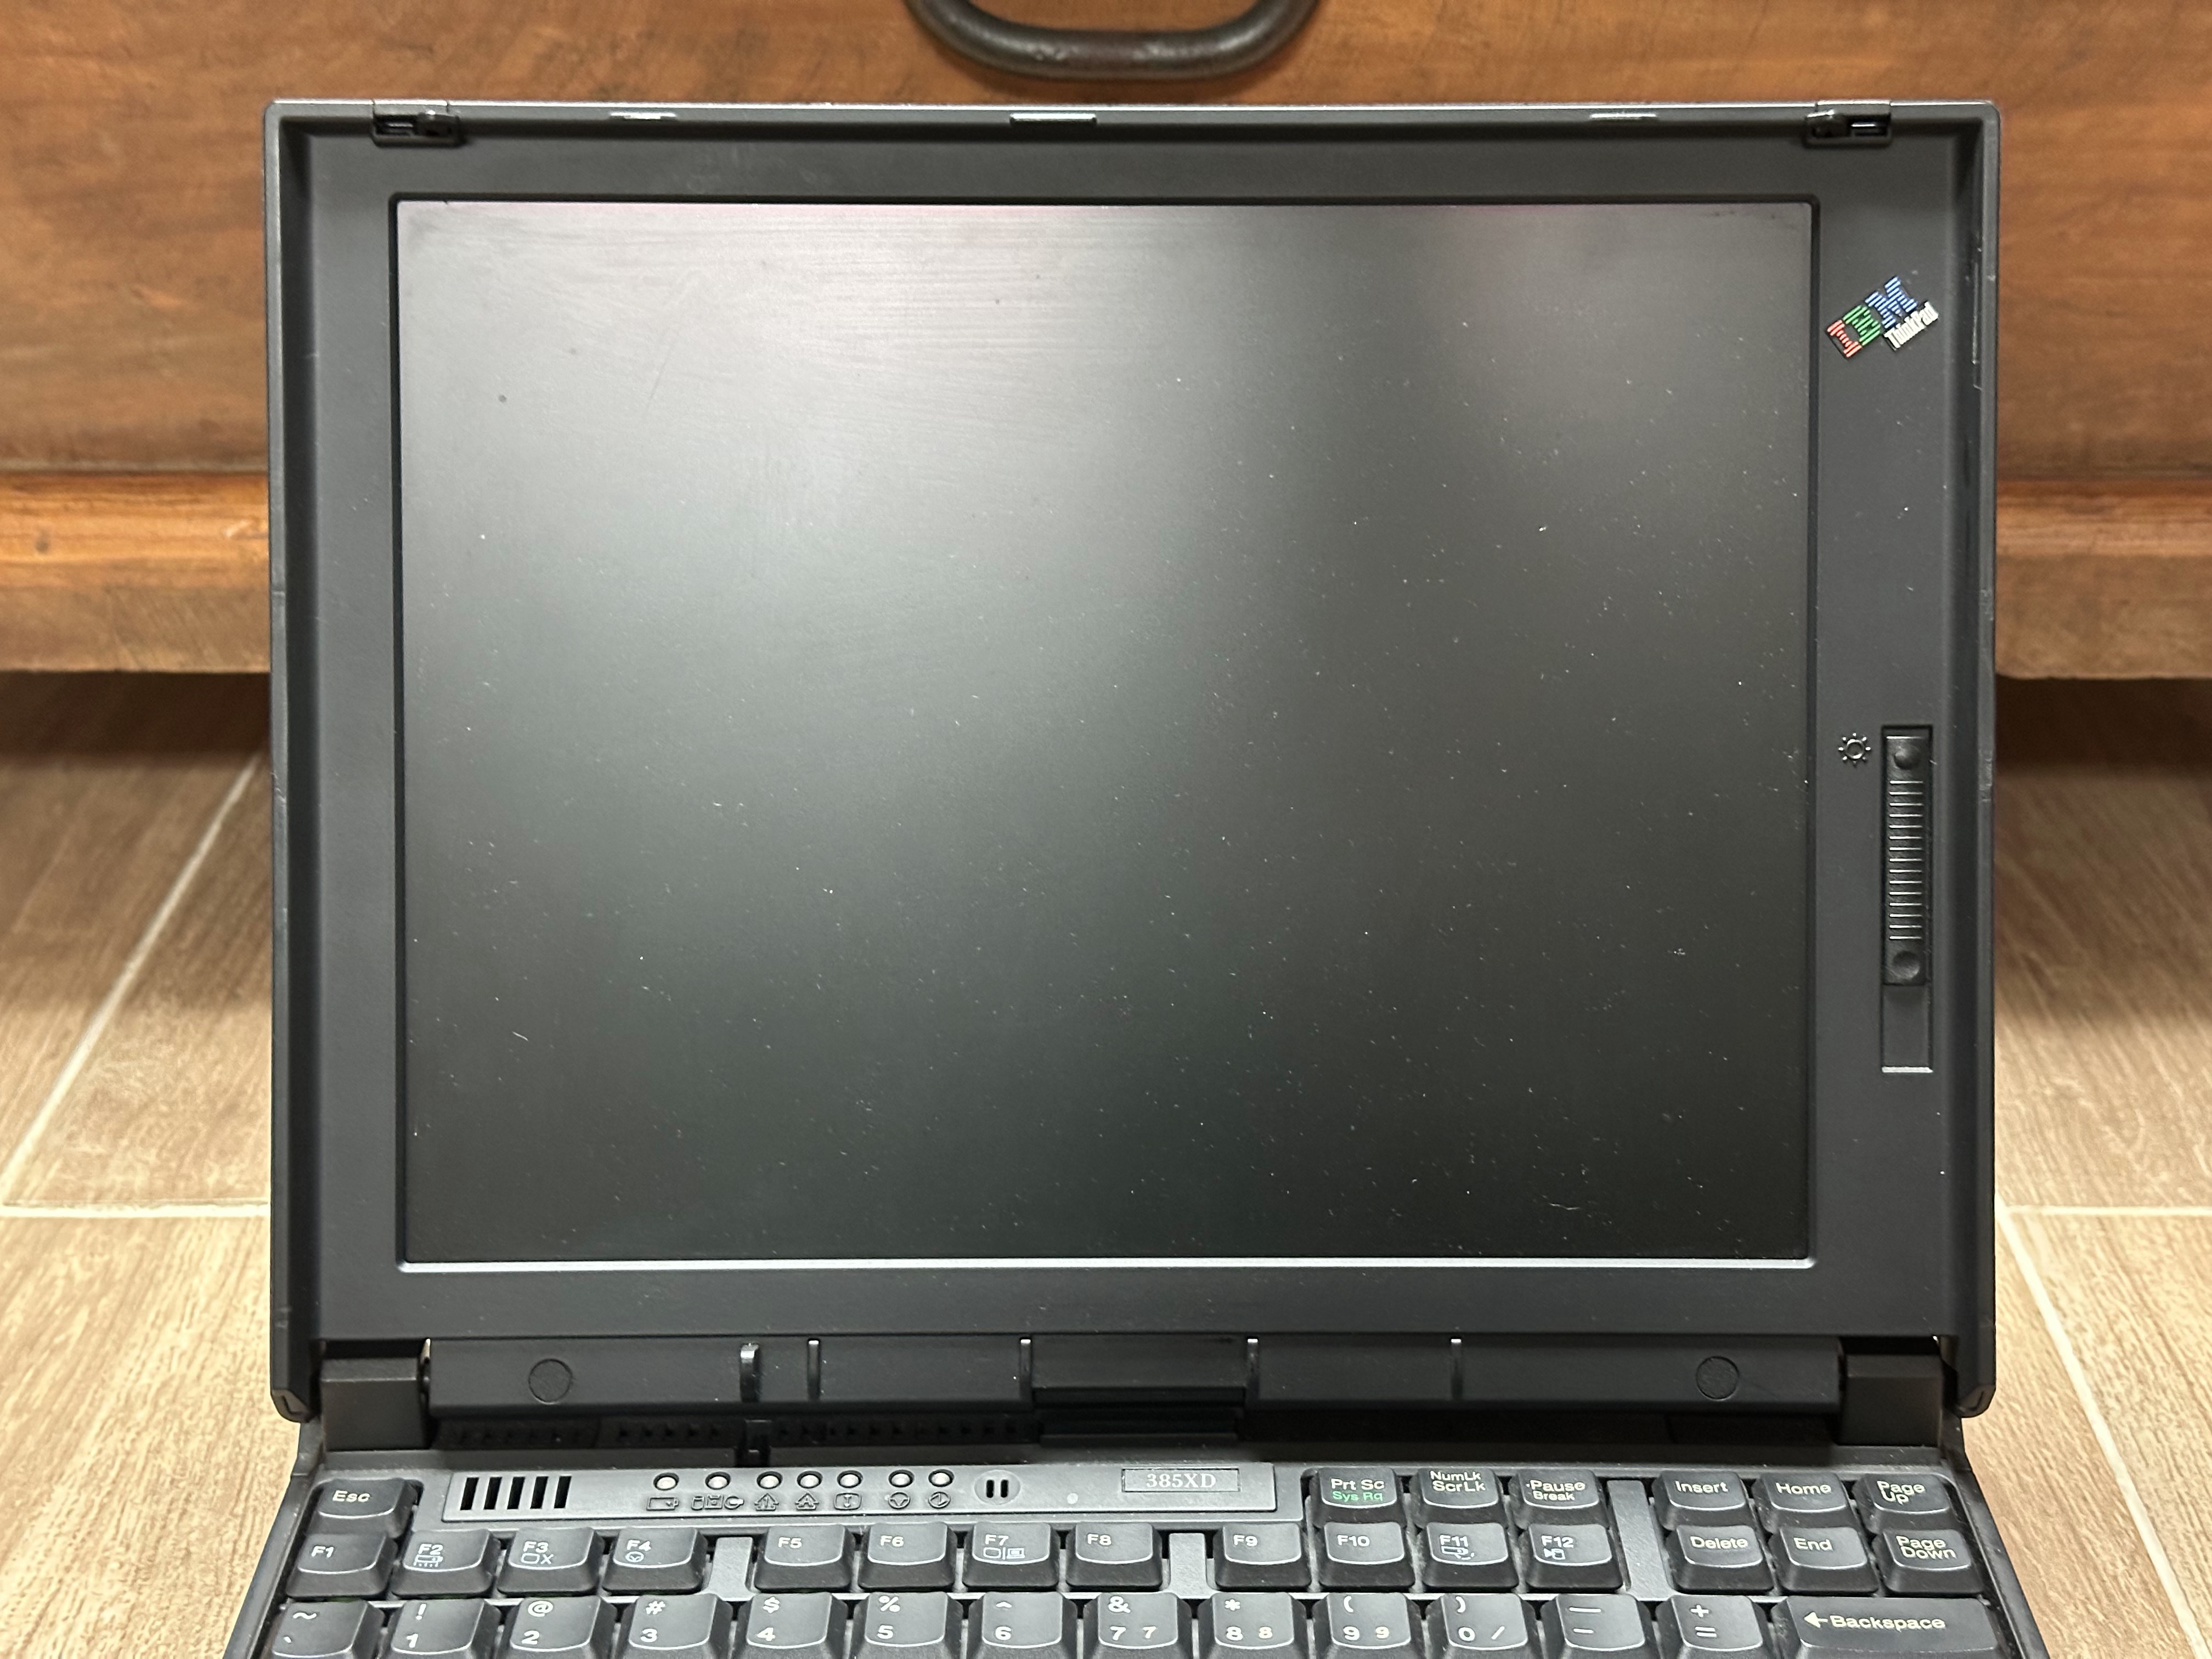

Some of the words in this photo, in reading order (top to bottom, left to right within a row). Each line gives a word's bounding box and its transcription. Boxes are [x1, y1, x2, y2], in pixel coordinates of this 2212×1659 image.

[1826, 276, 1918, 358] IBM
[1884, 301, 1939, 349] ThinkPad
[1144, 1472, 1218, 1491] 385XD
[1430, 1470, 1481, 1481] NumLk
[1331, 1478, 1357, 1491] Prt
[1361, 1479, 1385, 1491] Sc
[1432, 1479, 1486, 1492] ScrLk
[1530, 1480, 1585, 1493] Pause
[1675, 1481, 1729, 1493] Insert
[1775, 1482, 1832, 1495] Home
[1877, 1481, 1926, 1495] Page
[332, 1490, 370, 1503] Esc
[1332, 1491, 1358, 1502] Sys
[1362, 1491, 1384, 1502] Rq
[1533, 1489, 1576, 1501] Break
[1881, 1488, 1910, 1505] Up
[627, 1539, 651, 1553] F4
[778, 1537, 802, 1549] F5
[880, 1535, 904, 1547] F6
[985, 1534, 1009, 1546] F7
[1087, 1533, 1111, 1545] F8
[1233, 1534, 1258, 1547] F9
[1337, 1534, 1370, 1547] F10
[1440, 1534, 1469, 1547] F11
[1542, 1534, 1575, 1549] F12
[1690, 1536, 1748, 1549] Delete
[1793, 1537, 1833, 1551] End
[1897, 1536, 1946, 1551] Page
[311, 1545, 334, 1558] F1
[417, 1543, 443, 1554] F2
[523, 1541, 549, 1555] F3
[1901, 1545, 1956, 1560] Down
[527, 1600, 554, 1617] @
[645, 1601, 666, 1615] #
[763, 1596, 780, 1613] $
[879, 1594, 900, 1612] %
[1108, 1596, 1131, 1613] &
[1344, 1595, 1353, 1613] (
[1455, 1595, 1466, 1613] )
[415, 1603, 427, 1621] !
[1690, 1605, 1709, 1617] +
[1830, 1615, 1946, 1632] Backspace
[521, 1630, 540, 1645] 2
[640, 1628, 658, 1643] 3
[756, 1627, 776, 1641] 4
[877, 1625, 894, 1639] 5
[995, 1626, 1012, 1641] 6
[1110, 1626, 1126, 1641] 7
[1142, 1626, 1156, 1639] 7
[1226, 1626, 1244, 1641] 8
[1259, 1626, 1273, 1639] 8
[1343, 1626, 1360, 1640] 9
[1375, 1626, 1390, 1639] 9
[1458, 1627, 1475, 1641] 0
[1491, 1626, 1505, 1640] /
[1695, 1626, 1717, 1638] =
[406, 1633, 419, 1648] 1
